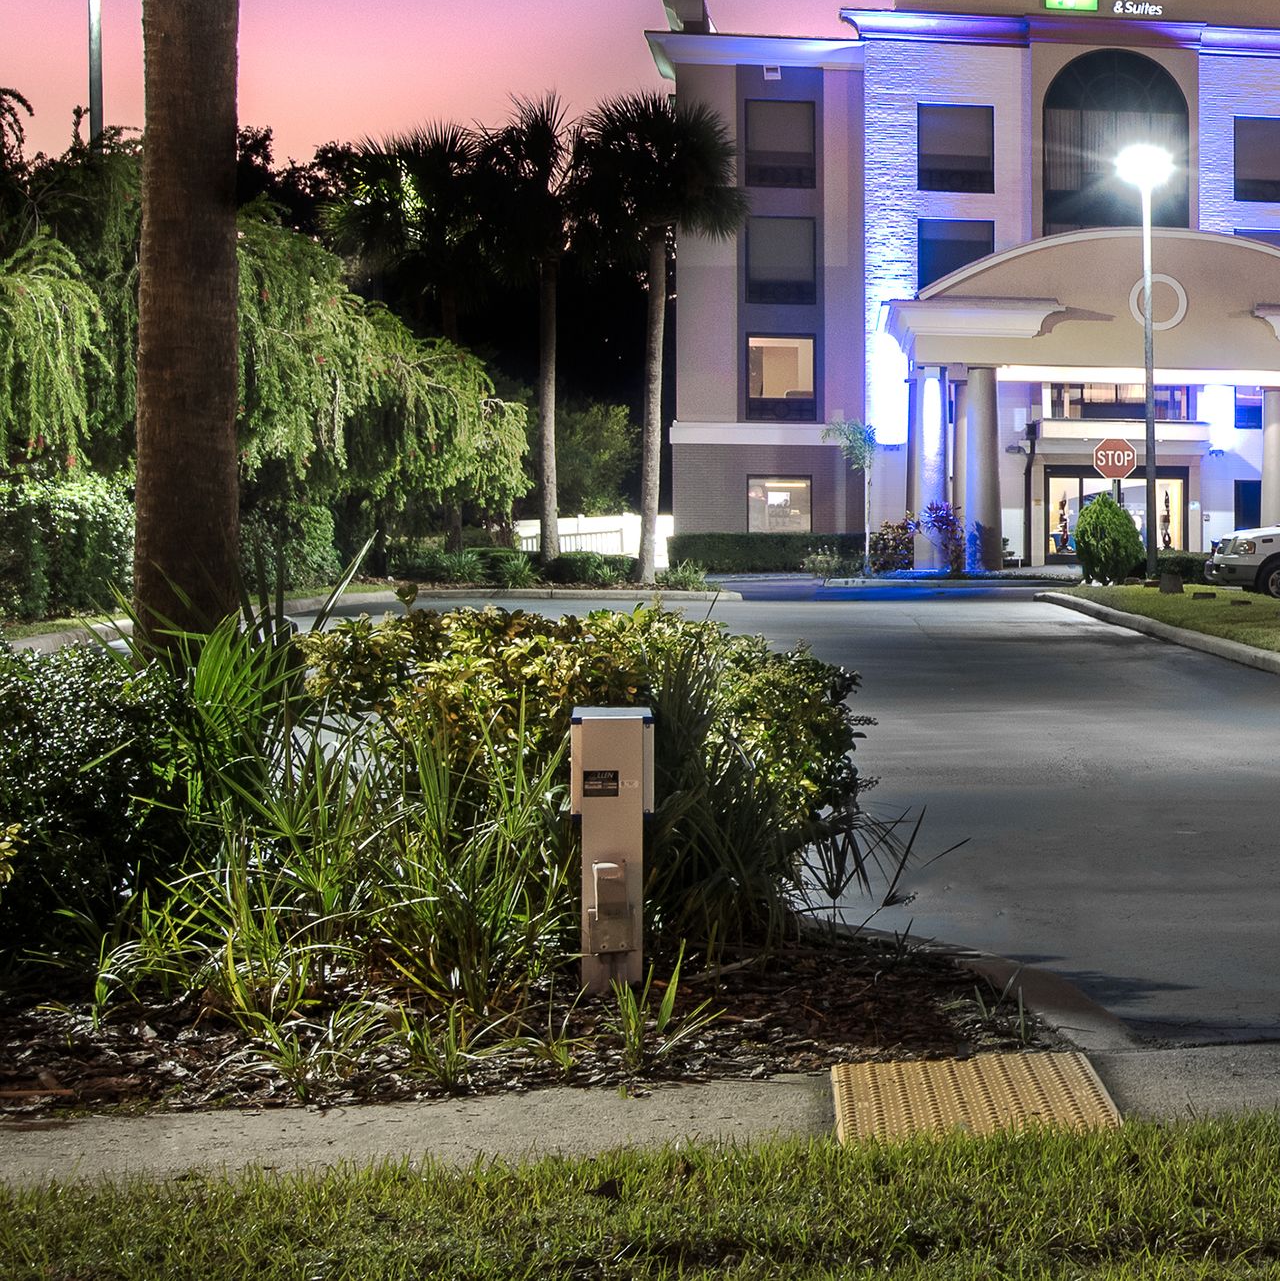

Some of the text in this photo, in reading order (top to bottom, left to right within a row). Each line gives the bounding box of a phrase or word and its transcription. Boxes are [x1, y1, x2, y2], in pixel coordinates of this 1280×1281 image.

[1113, 0, 1163, 16] & Suites
[1097, 450, 1133, 466] STOP
